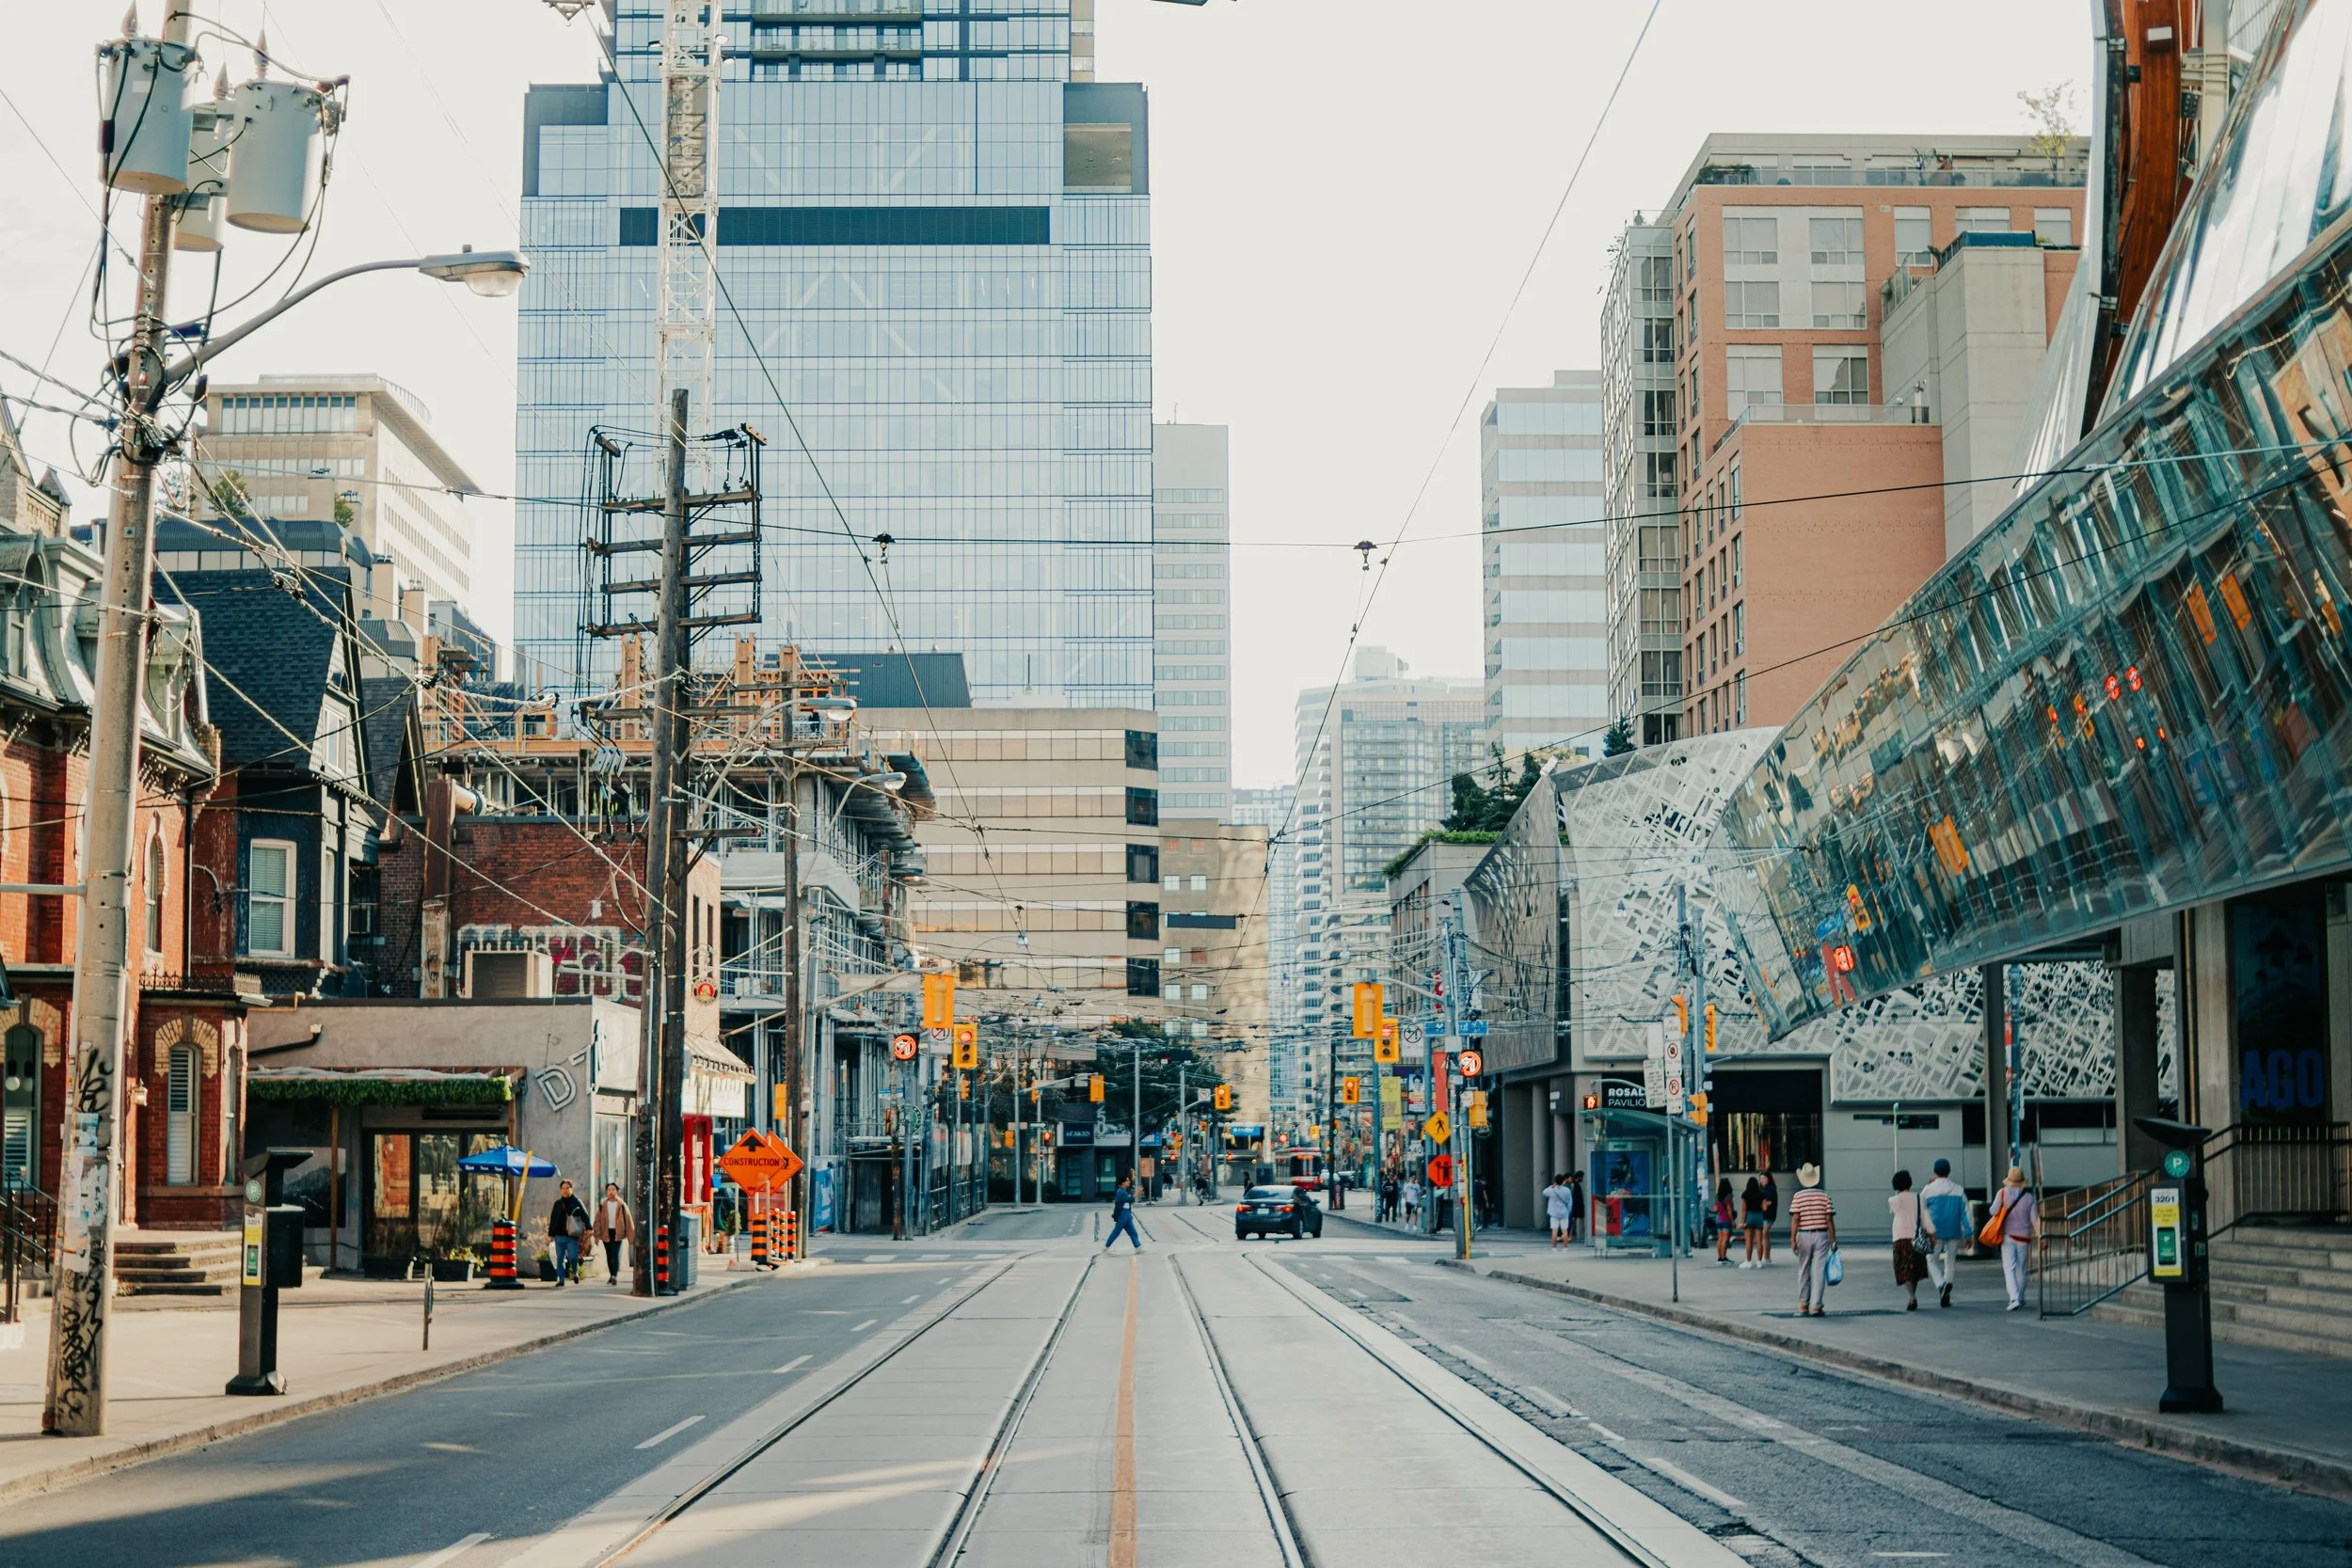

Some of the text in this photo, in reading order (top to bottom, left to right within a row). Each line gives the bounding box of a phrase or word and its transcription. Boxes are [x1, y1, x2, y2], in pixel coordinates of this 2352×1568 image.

[2240, 1048, 2324, 1109] AGO
[1608, 1087, 1645, 1097] ROSAL
[1608, 1098, 1646, 1106] PAVILIO
[723, 1157, 780, 1167] CONSTRUCTION
[2154, 1195, 2175, 1203] 3201
